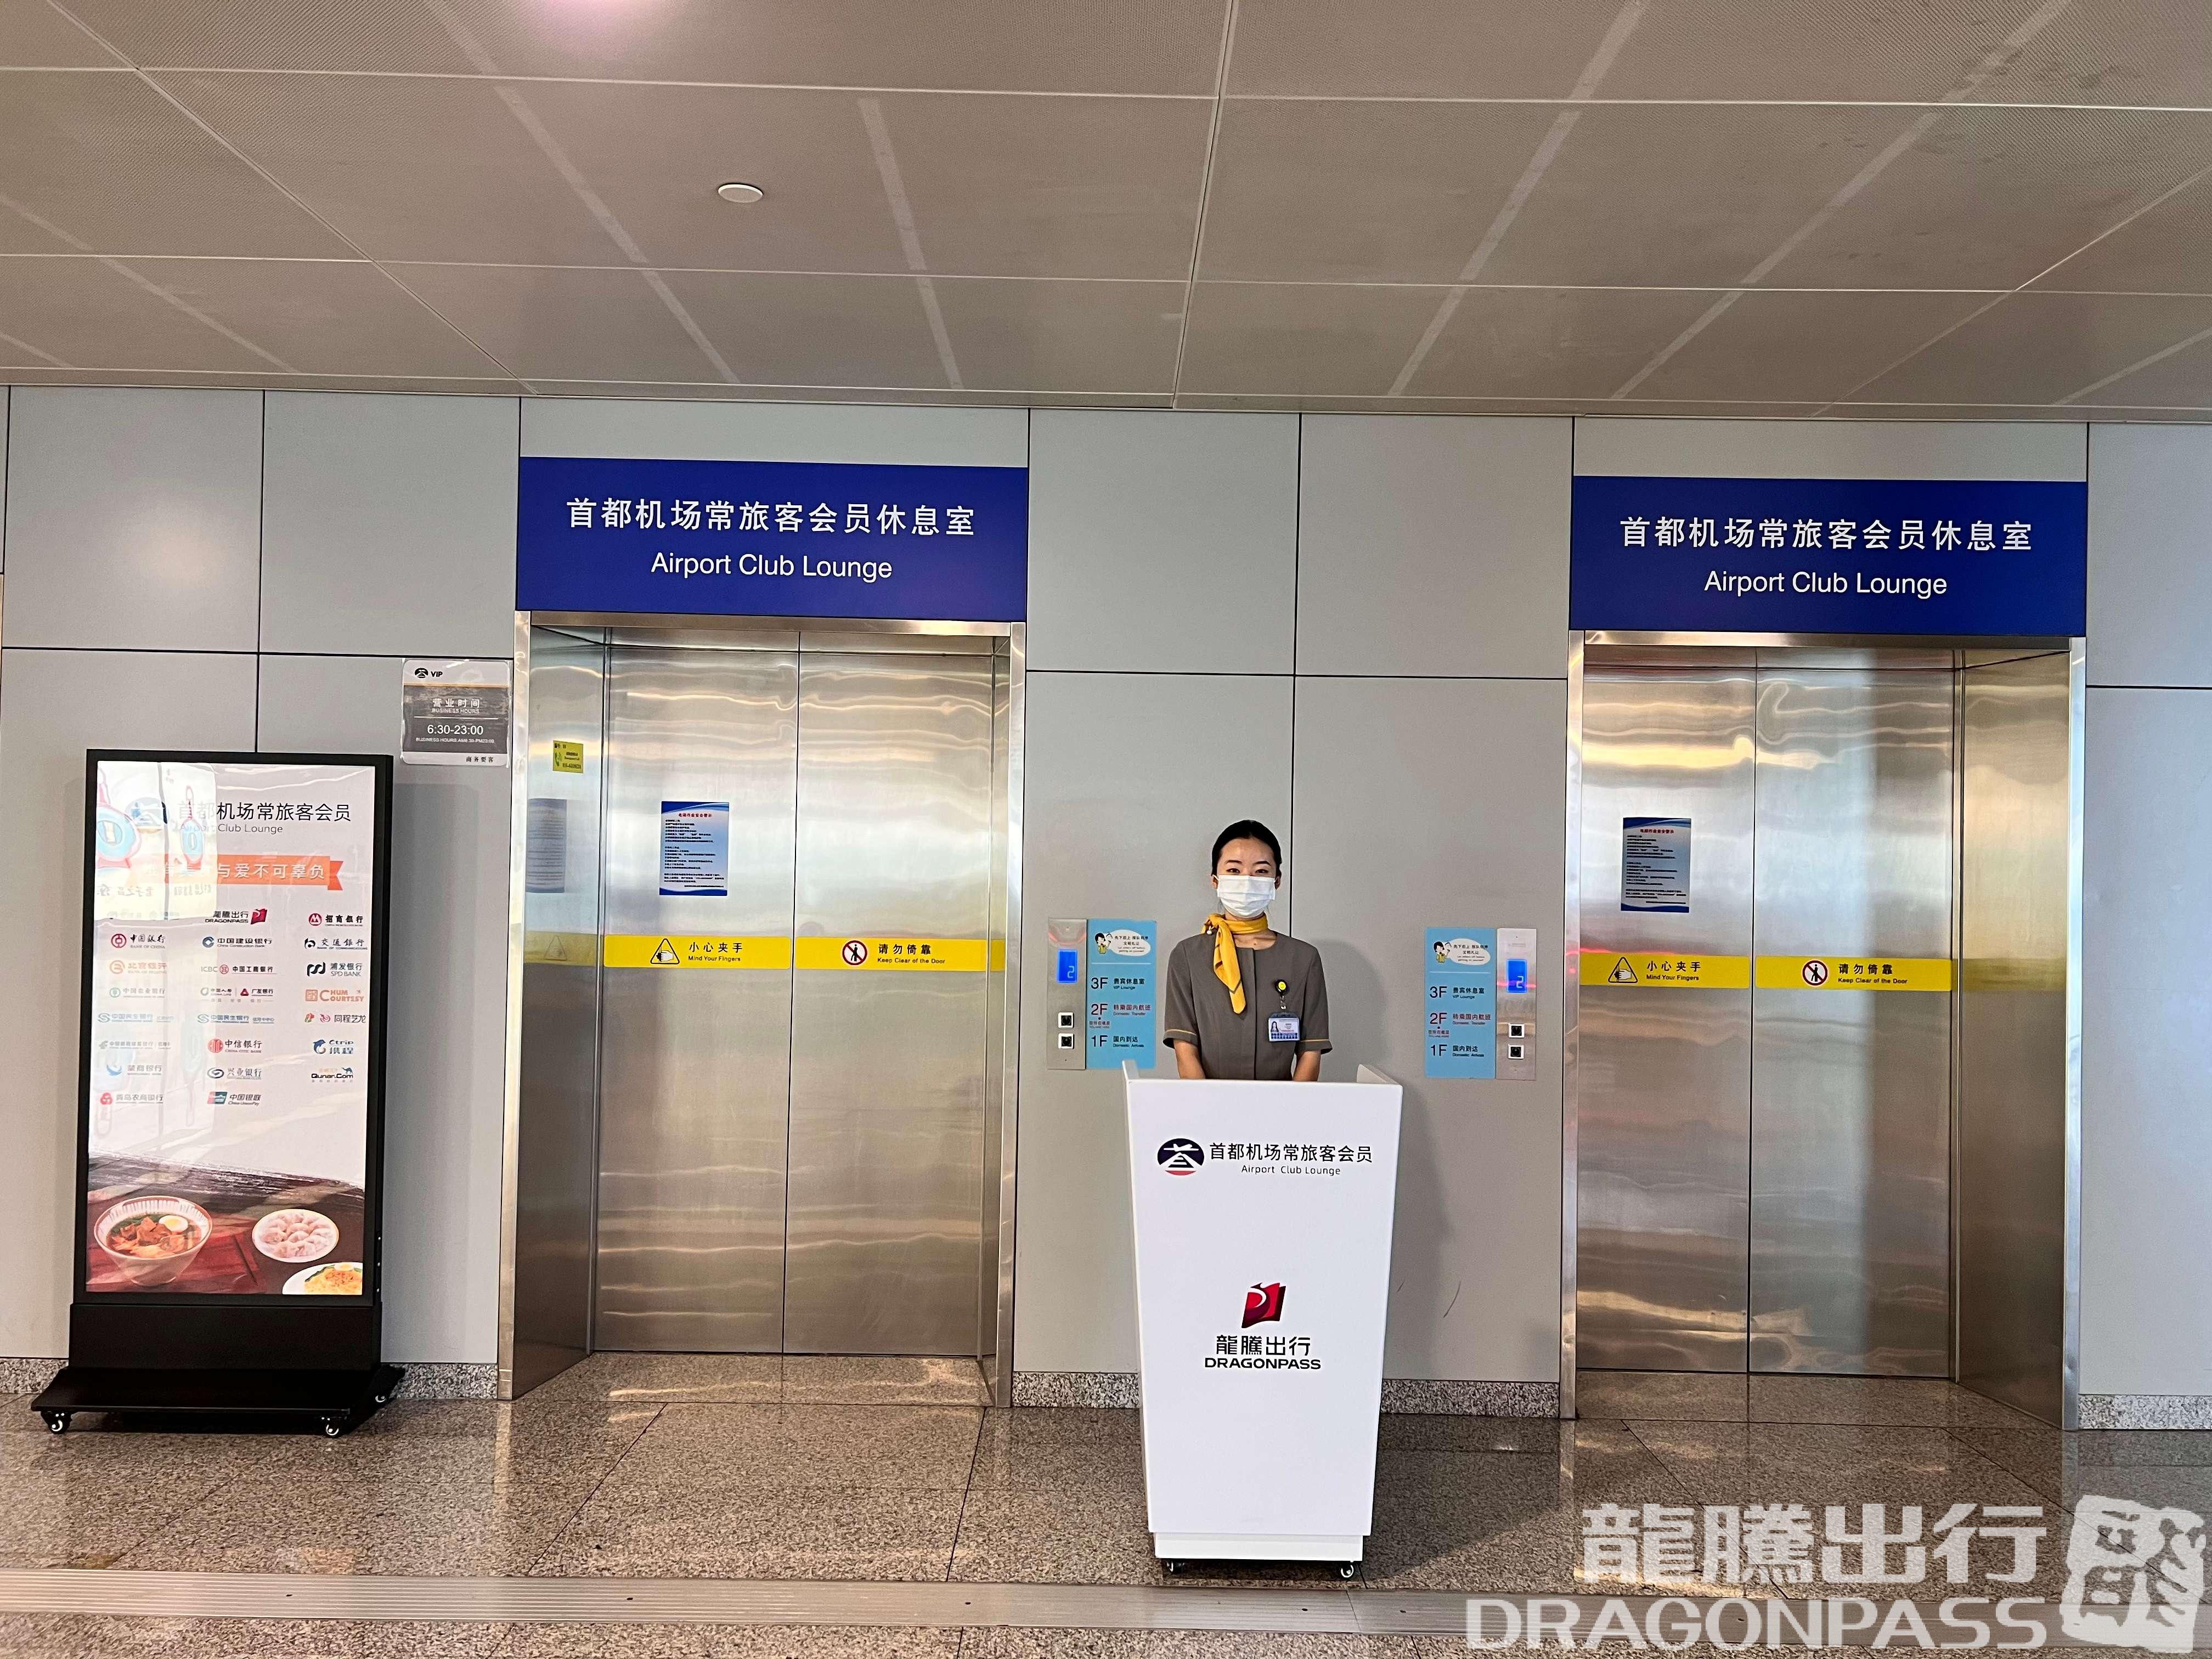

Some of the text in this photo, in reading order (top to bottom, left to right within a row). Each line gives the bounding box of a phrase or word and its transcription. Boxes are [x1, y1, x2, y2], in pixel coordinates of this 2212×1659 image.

[566, 497, 975, 537] 首都机场常旅客会员休息室
[1620, 516, 2033, 551] 首都机场常旅客会员休息室
[651, 552, 893, 583] Airport Club Lounge
[1704, 571, 1948, 599] Airport Club Lounge
[432, 698, 480, 708] 营业时间
[427, 725, 484, 735] 6:30-23:00
[218, 823, 241, 832] Club
[244, 824, 283, 835] Lounge
[321, 938, 364, 946] 交通银行
[689, 941, 743, 953] 小心夹手
[878, 944, 931, 955] 请勿倚靠
[1067, 965, 1075, 978] 2
[1646, 960, 1701, 972] 小心夹手
[1838, 963, 1893, 975] 请勿倚靠
[1091, 977, 1108, 989] 3F
[1516, 975, 1524, 989] 2
[1429, 986, 1447, 998] 3F
[1091, 1003, 1108, 1015] 2F
[334, 1014, 366, 1023] 同程艺龙
[1429, 1012, 1447, 1024] 2F
[224, 1039, 263, 1048] 中信银行
[1091, 1035, 1108, 1047] 1F
[1430, 1044, 1448, 1057] 1F
[227, 1068, 262, 1077] 兴业银行
[1209, 1142, 1373, 1163] 首都机场常旅客会员
[1241, 1164, 1341, 1177] Airport Club Lounge
[1215, 1334, 1311, 1357] 龍騰出行
[1204, 1357, 1322, 1370] DRAGONPASS
